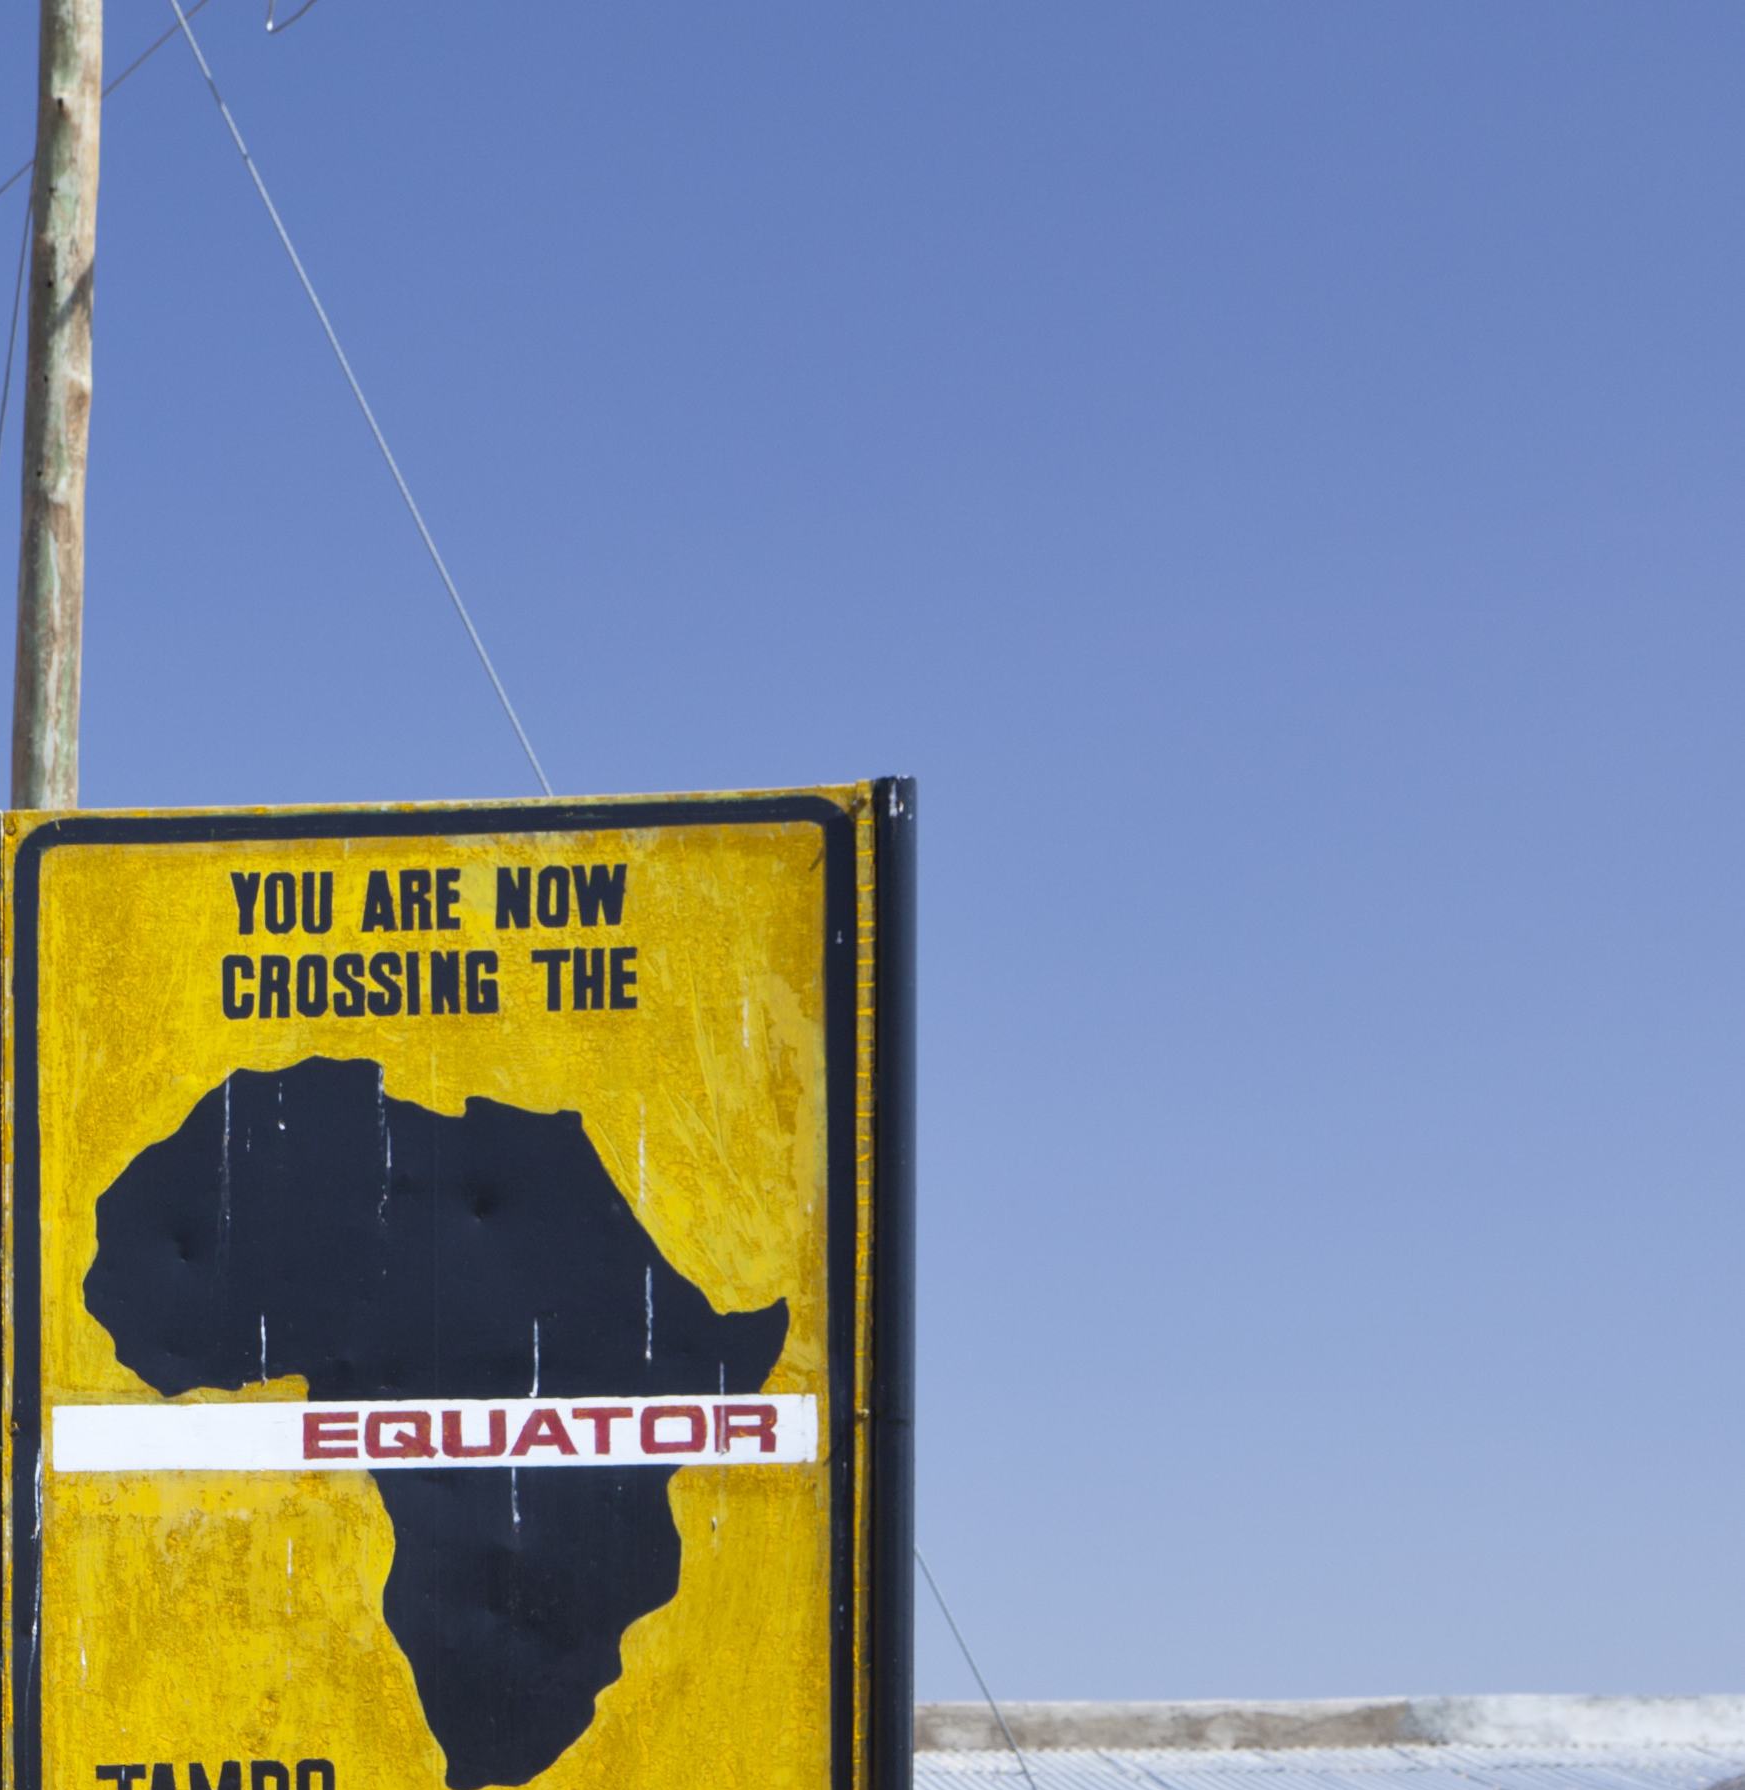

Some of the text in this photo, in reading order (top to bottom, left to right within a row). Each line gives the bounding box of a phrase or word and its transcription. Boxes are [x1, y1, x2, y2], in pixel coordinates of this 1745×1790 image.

[231, 864, 626, 934] YOU ARE NOW
[223, 947, 637, 1019] CROSSING THE
[304, 1406, 776, 1458] EQUATOR
